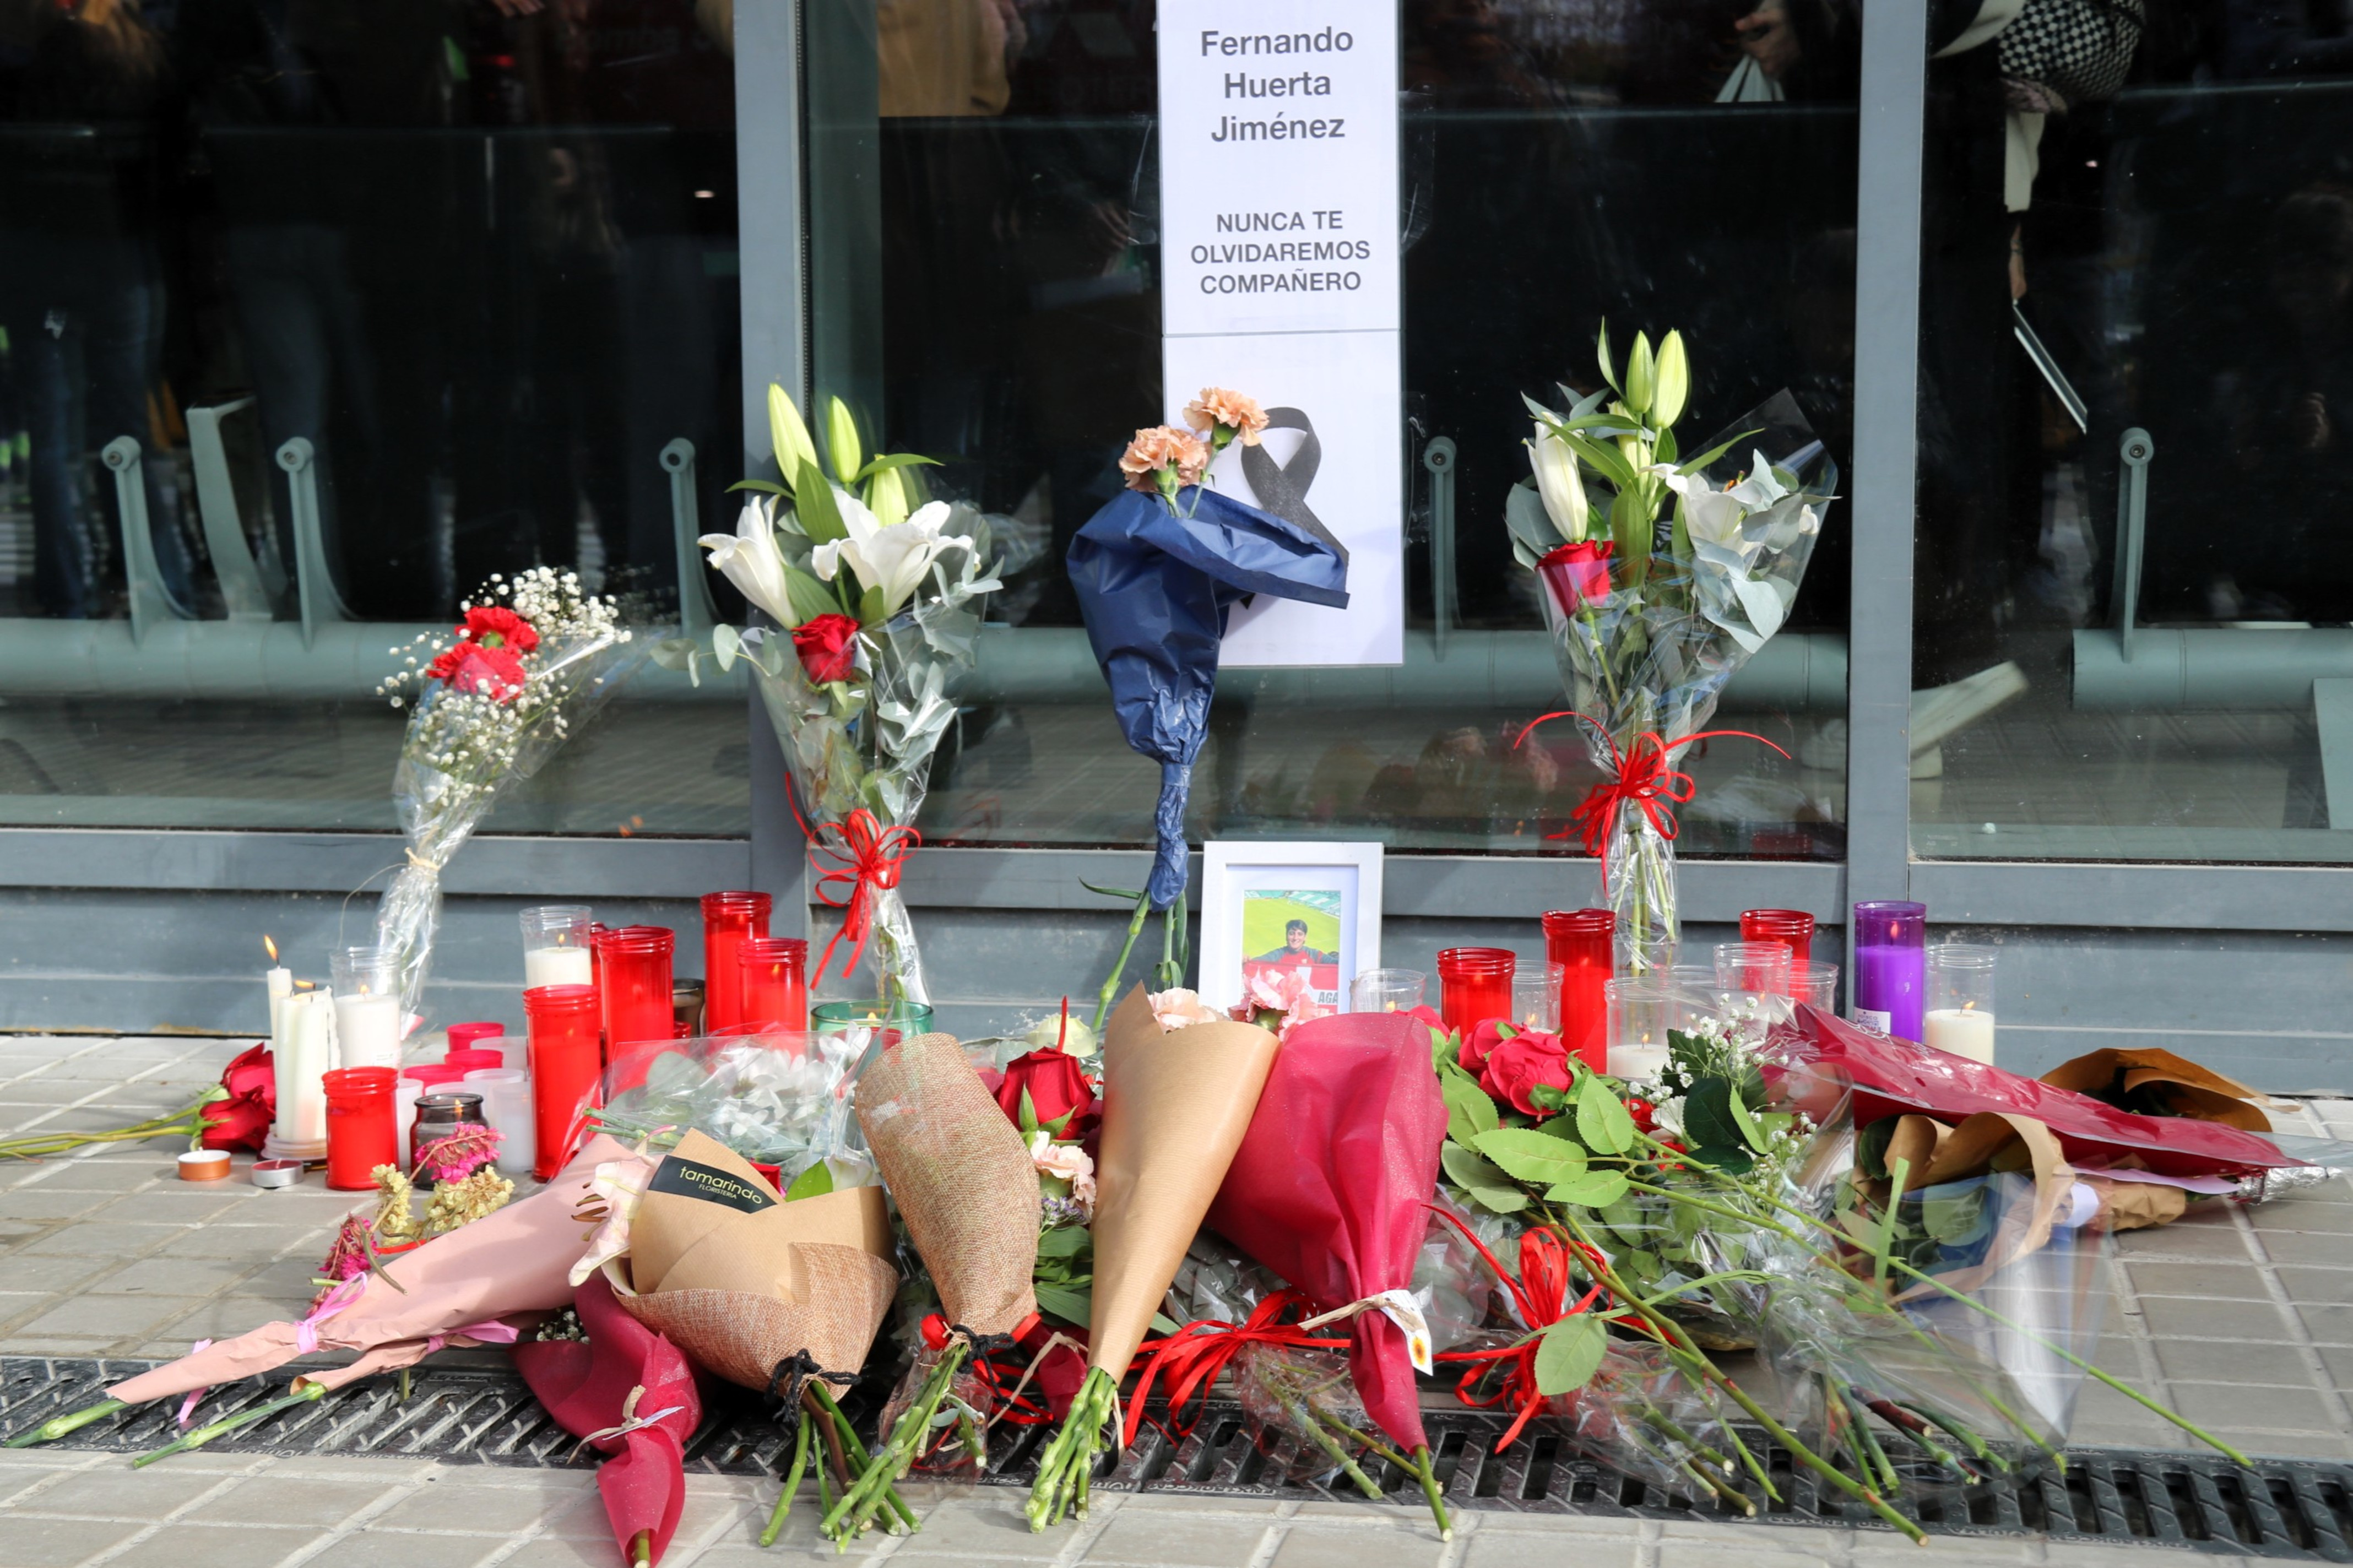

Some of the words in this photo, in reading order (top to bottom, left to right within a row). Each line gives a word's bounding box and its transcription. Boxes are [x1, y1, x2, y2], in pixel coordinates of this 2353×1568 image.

[1202, 26, 1353, 56] Fernando
[1225, 72, 1330, 98] Huerta
[1212, 112, 1344, 142] Jiménez
[1217, 212, 1305, 232] NUNCA
[1313, 211, 1342, 229] TE
[1191, 241, 1370, 264] OLVIDAREMOS
[1201, 268, 1360, 294] COMPAÑERO
[679, 1166, 762, 1204] tamarindo
[698, 1184, 737, 1200] FLORISTERIA
